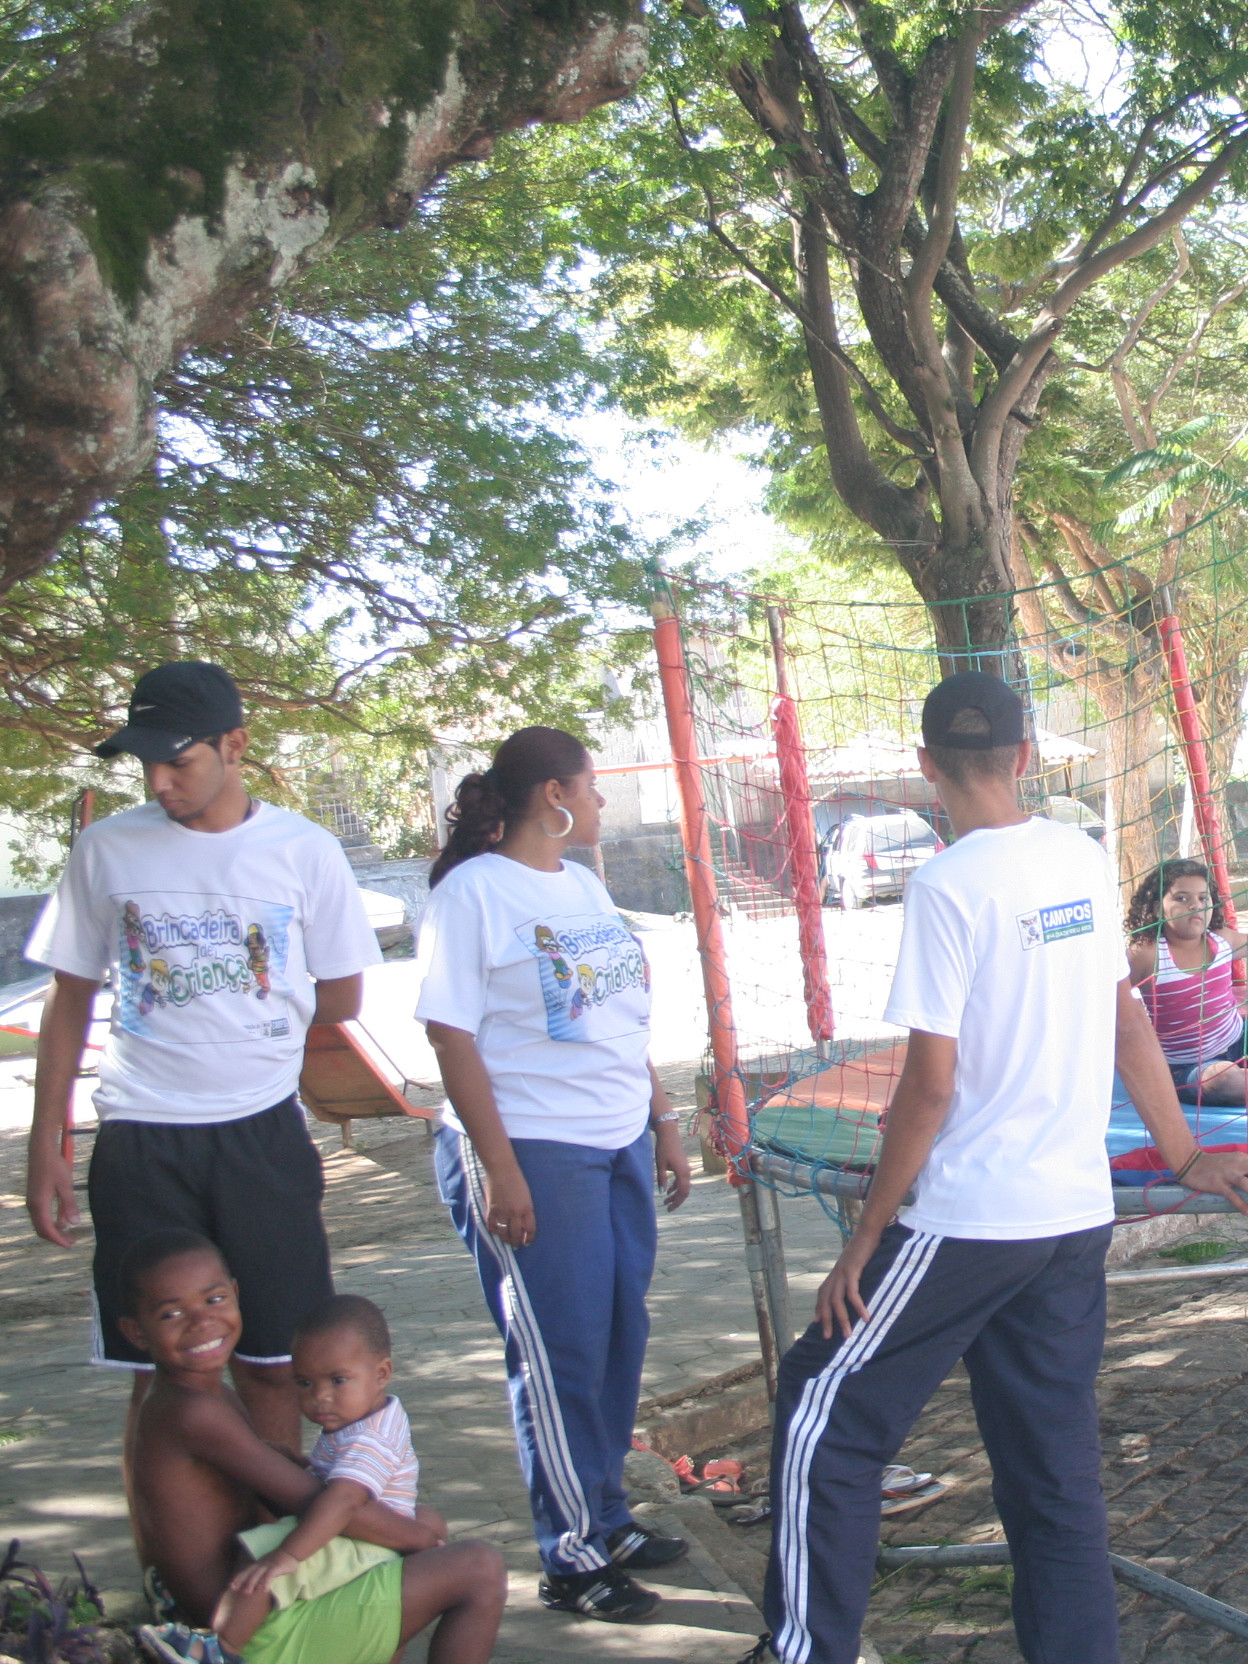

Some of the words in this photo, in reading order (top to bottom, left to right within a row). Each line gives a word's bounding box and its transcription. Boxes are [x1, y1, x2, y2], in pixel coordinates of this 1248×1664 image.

[142, 913, 242, 950] Brincadeira
[1043, 903, 1092, 928] CAMPOS
[200, 943, 215, 958] de
[169, 956, 250, 1002] Criança
[594, 951, 643, 1002] Criança
